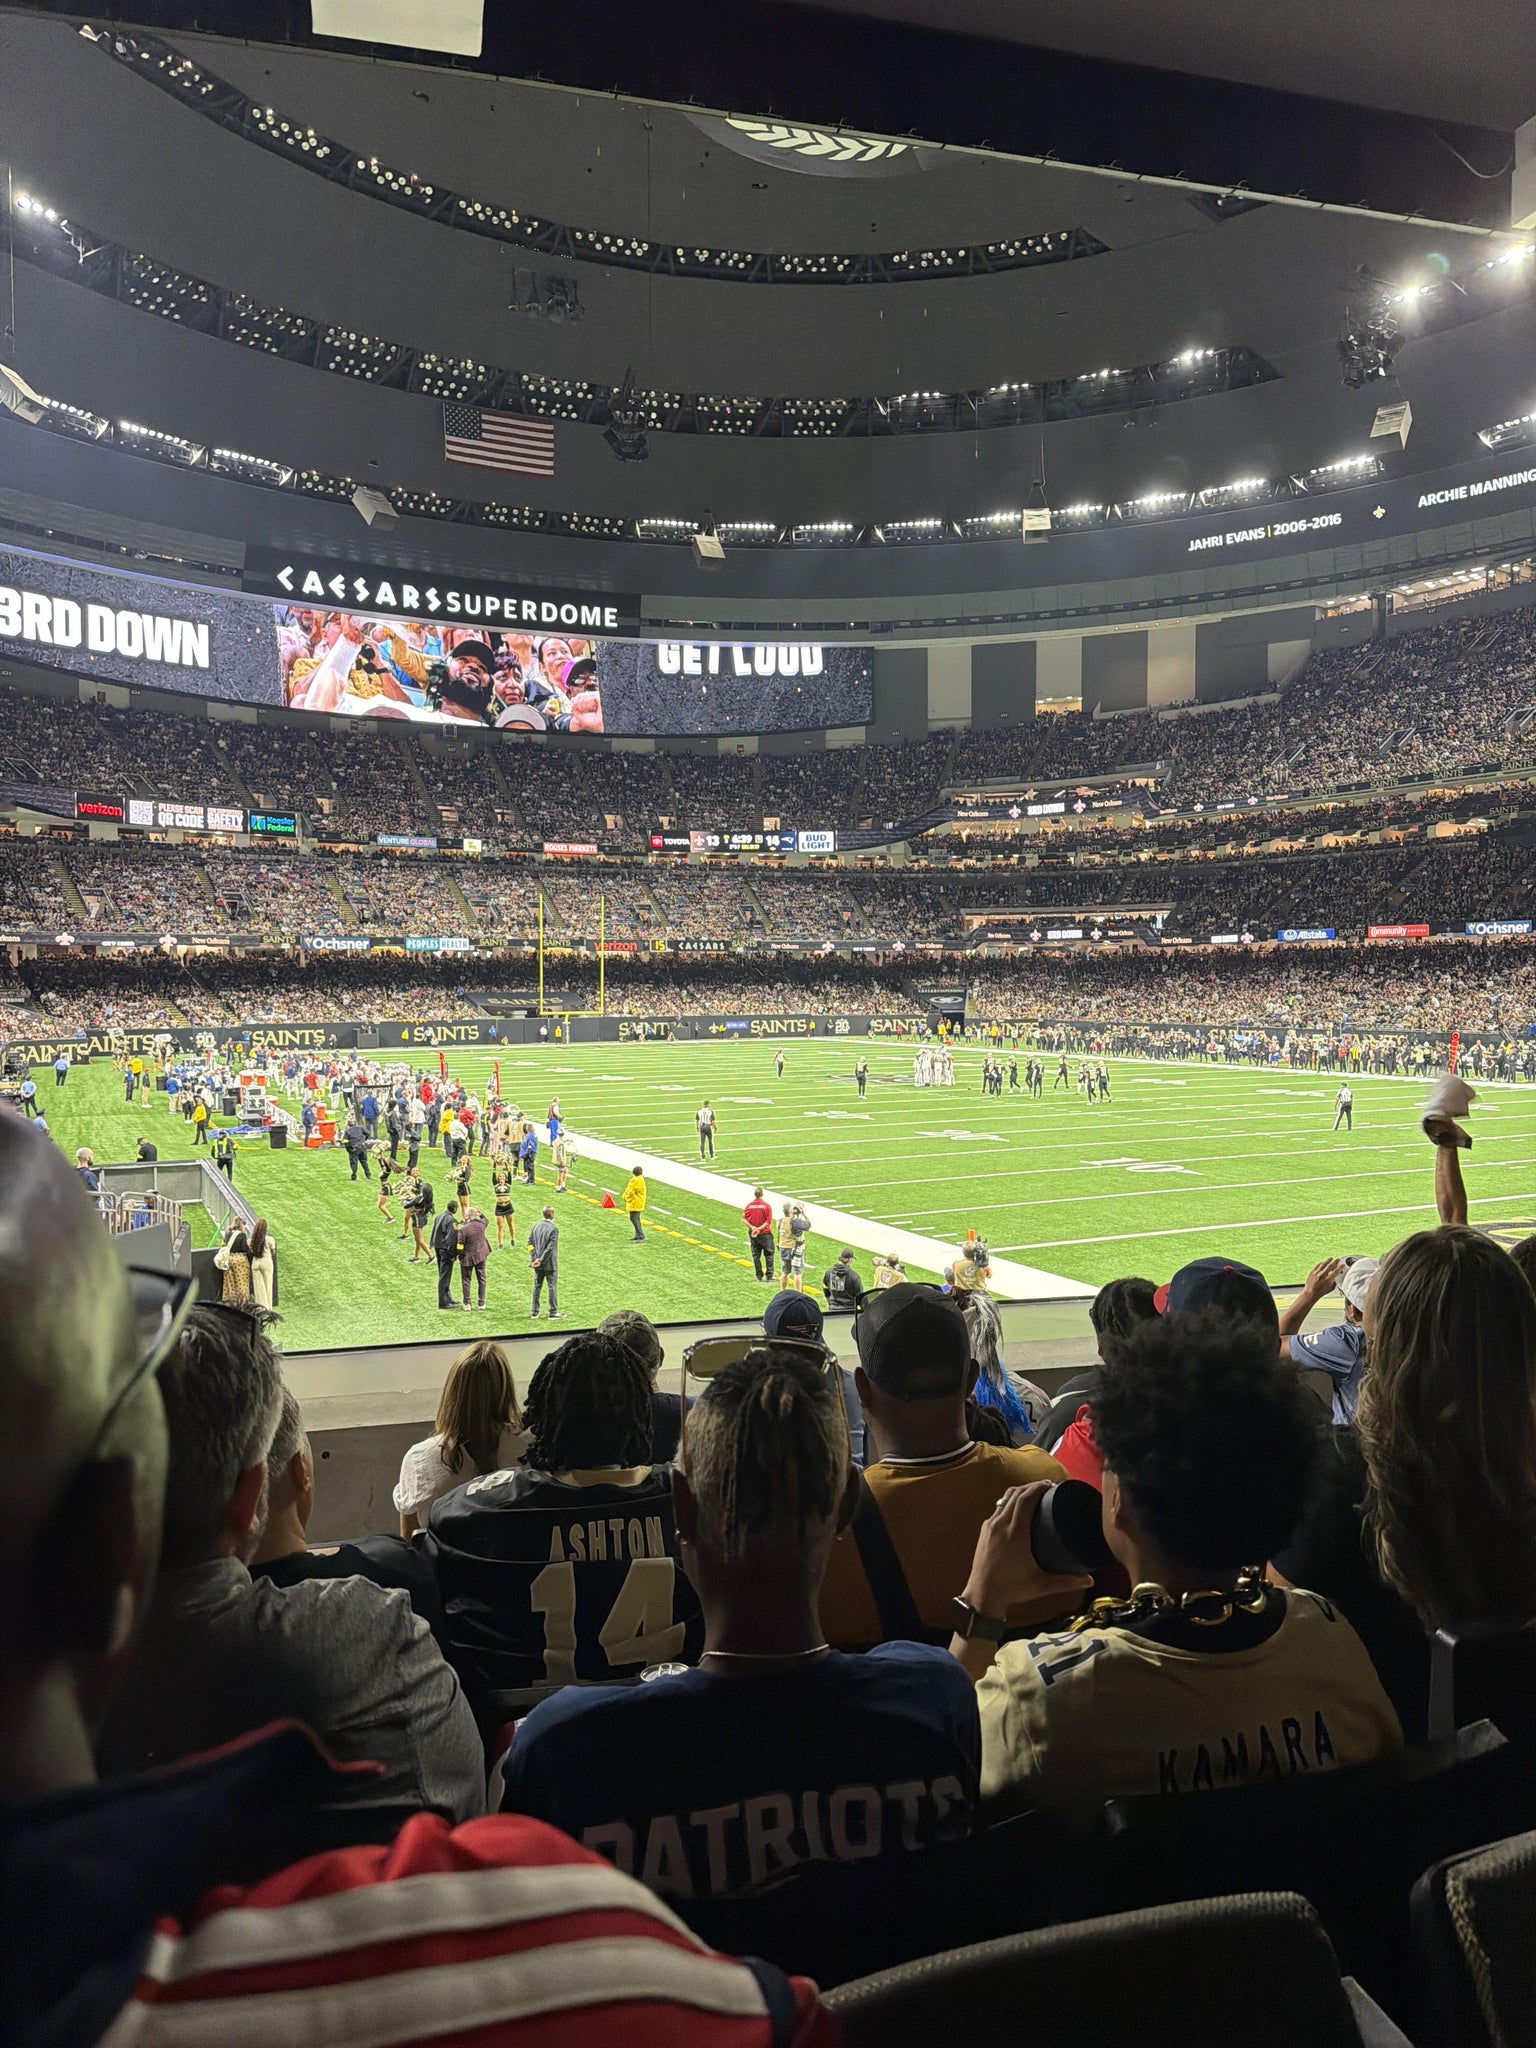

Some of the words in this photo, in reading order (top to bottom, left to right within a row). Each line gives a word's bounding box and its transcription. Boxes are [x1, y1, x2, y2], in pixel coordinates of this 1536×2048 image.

[1417, 486, 1468, 508] ARCHIE
[1470, 468, 1536, 498] MANNING
[1188, 535, 1224, 553] JAHRI
[1226, 527, 1266, 546] EVANS
[1273, 513, 1342, 537] 2006-2016
[276, 565, 442, 613] CAESARS
[446, 591, 619, 628] SUPERDOME
[0, 586, 82, 648] 3RD
[88, 604, 210, 669] DOWN
[733, 646, 823, 677] LOUD
[1501, 760, 1534, 770] SAINTS
[1433, 769, 1464, 779] SAINTS
[1370, 779, 1399, 788] SAINTS
[1309, 788, 1337, 796] SAINTS
[79, 803, 122, 816] verizon
[159, 803, 184, 813] PLEASE
[184, 805, 203, 816] SCAN
[1489, 805, 1519, 815] SAINTS
[158, 812, 174, 827] QR
[175, 813, 204, 829] CODE
[207, 813, 243, 826] SAFETY
[1424, 812, 1453, 821] SAINTS
[267, 824, 294, 832] Federal
[1303, 825, 1329, 834] SAINTS
[1361, 820, 1389, 829] SAINTS
[379, 836, 410, 845] VENTURE
[410, 838, 436, 847] GLOBAL
[705, 835, 720, 847] 13
[765, 835, 780, 847] 14
[805, 834, 827, 842] BUD
[1338, 928, 1365, 937] SAINTS
[1371, 927, 1407, 937] Community
[1476, 922, 1530, 935] Ochsner
[206, 937, 230, 945] Orleans
[262, 935, 296, 944] SAINTS
[312, 937, 369, 950] Ochsner
[407, 939, 439, 949] PEOPLES
[440, 939, 468, 949] HEALTH
[543, 939, 571, 947] SAINTS
[654, 940, 665, 950] 15
[594, 940, 638, 951] verizon
[678, 942, 725, 950] CAESARS
[487, 997, 563, 1006] SAINTS
[619, 1021, 676, 1037] SAINT
[750, 1018, 807, 1034] SAINTS
[252, 1029, 326, 1047] SAINTS
[413, 1025, 480, 1042] SAINTS
[89, 1033, 157, 1053] AINTS
[550, 1516, 665, 1562] ASHTON
[530, 1556, 686, 1687] 14
[1159, 1710, 1335, 1794] KAMARA
